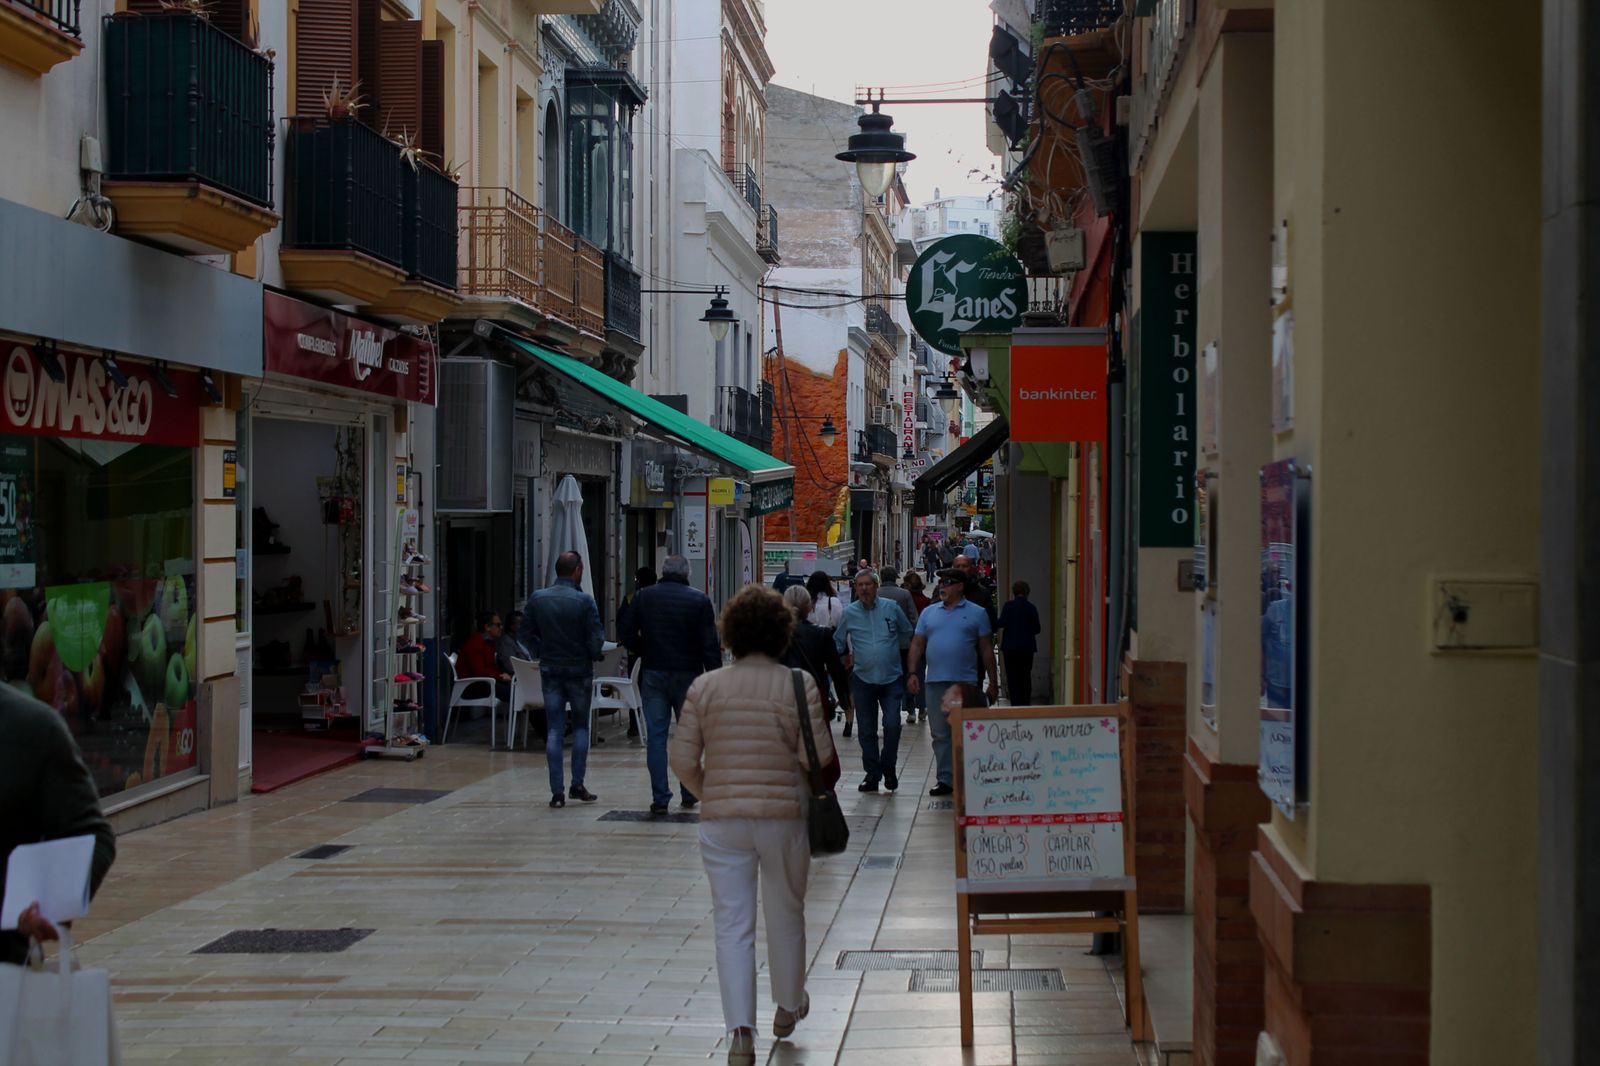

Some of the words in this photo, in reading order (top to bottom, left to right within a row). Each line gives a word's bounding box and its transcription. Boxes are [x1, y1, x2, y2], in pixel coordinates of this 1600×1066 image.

[979, 266, 1018, 280] Tiendas
[1169, 252, 1195, 525] Herbolario
[903, 391, 914, 453] RESTAURAN
[894, 459, 925, 470] CHNO
[988, 720, 1034, 750] Ofertas
[971, 754, 1007, 780] Jalea
[1011, 751, 1041, 772] Real
[973, 836, 1012, 854] OMEGA
[1017, 834, 1026, 854] 3
[1048, 836, 1091, 852] CAPILAR
[975, 858, 996, 874] 150
[1048, 855, 1093, 873] BIOTINA
